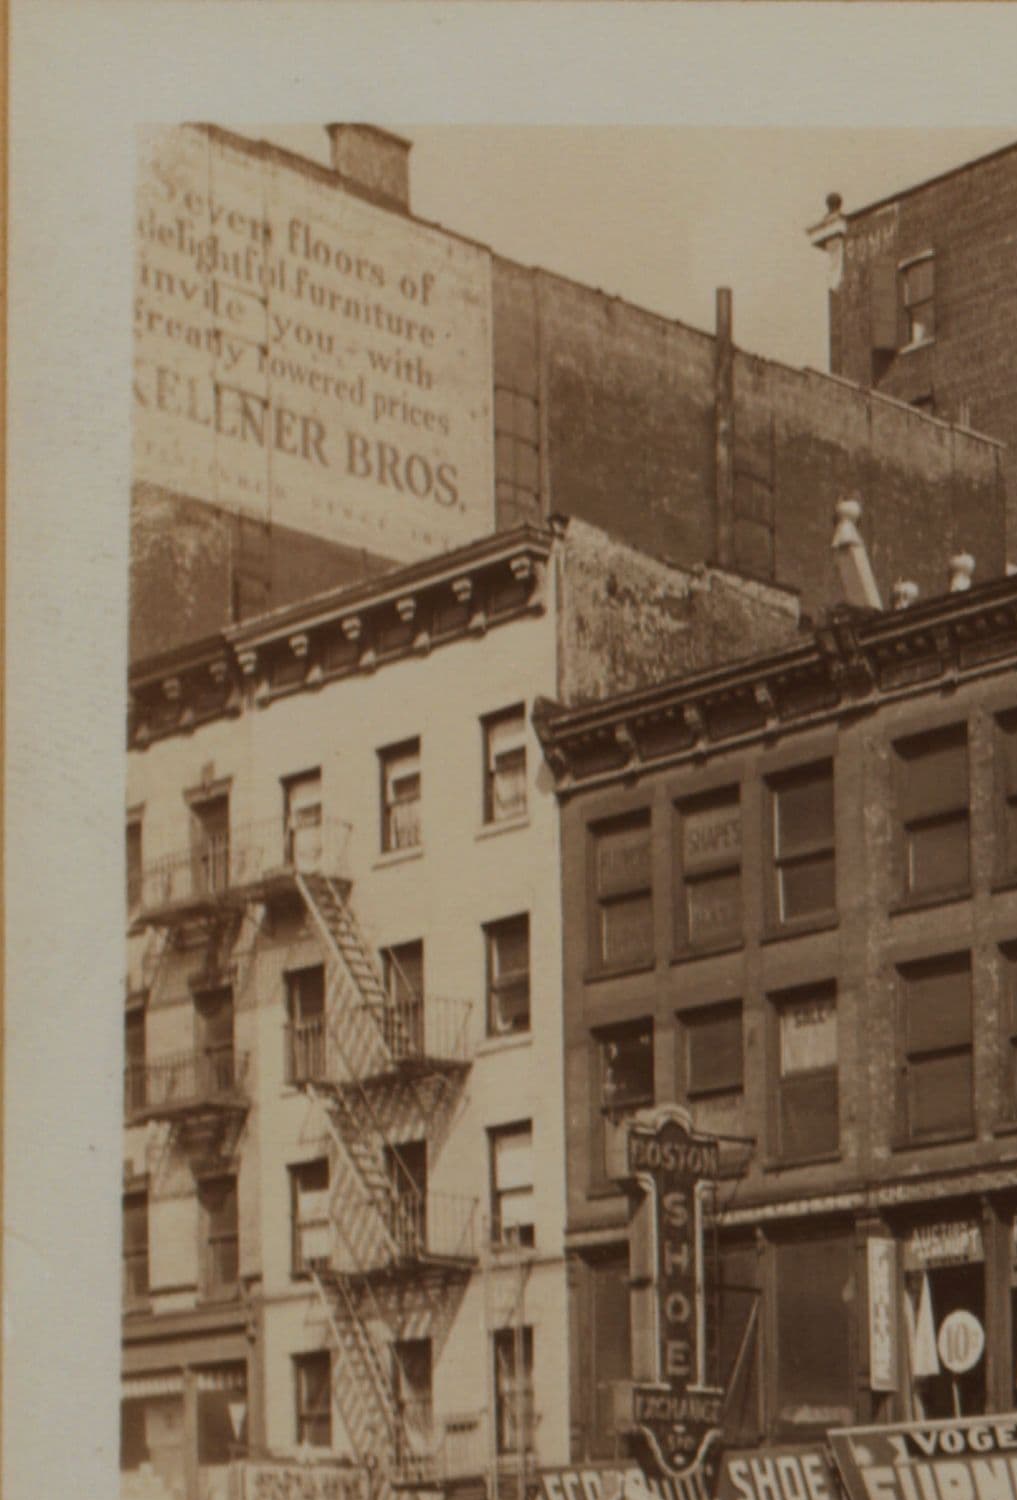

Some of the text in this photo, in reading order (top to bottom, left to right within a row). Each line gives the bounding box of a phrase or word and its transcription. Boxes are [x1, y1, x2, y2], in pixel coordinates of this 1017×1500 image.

[288, 218, 386, 289] floors
[400, 270, 437, 307] of
[138, 262, 436, 392] invite you with
[295, 267, 436, 349] furniture
[257, 344, 366, 407] lowered
[372, 392, 451, 437] prices
[346, 430, 467, 514] BROS.
[629, 1138, 718, 1176] BOSTON
[662, 1190, 692, 1377] SHOE
